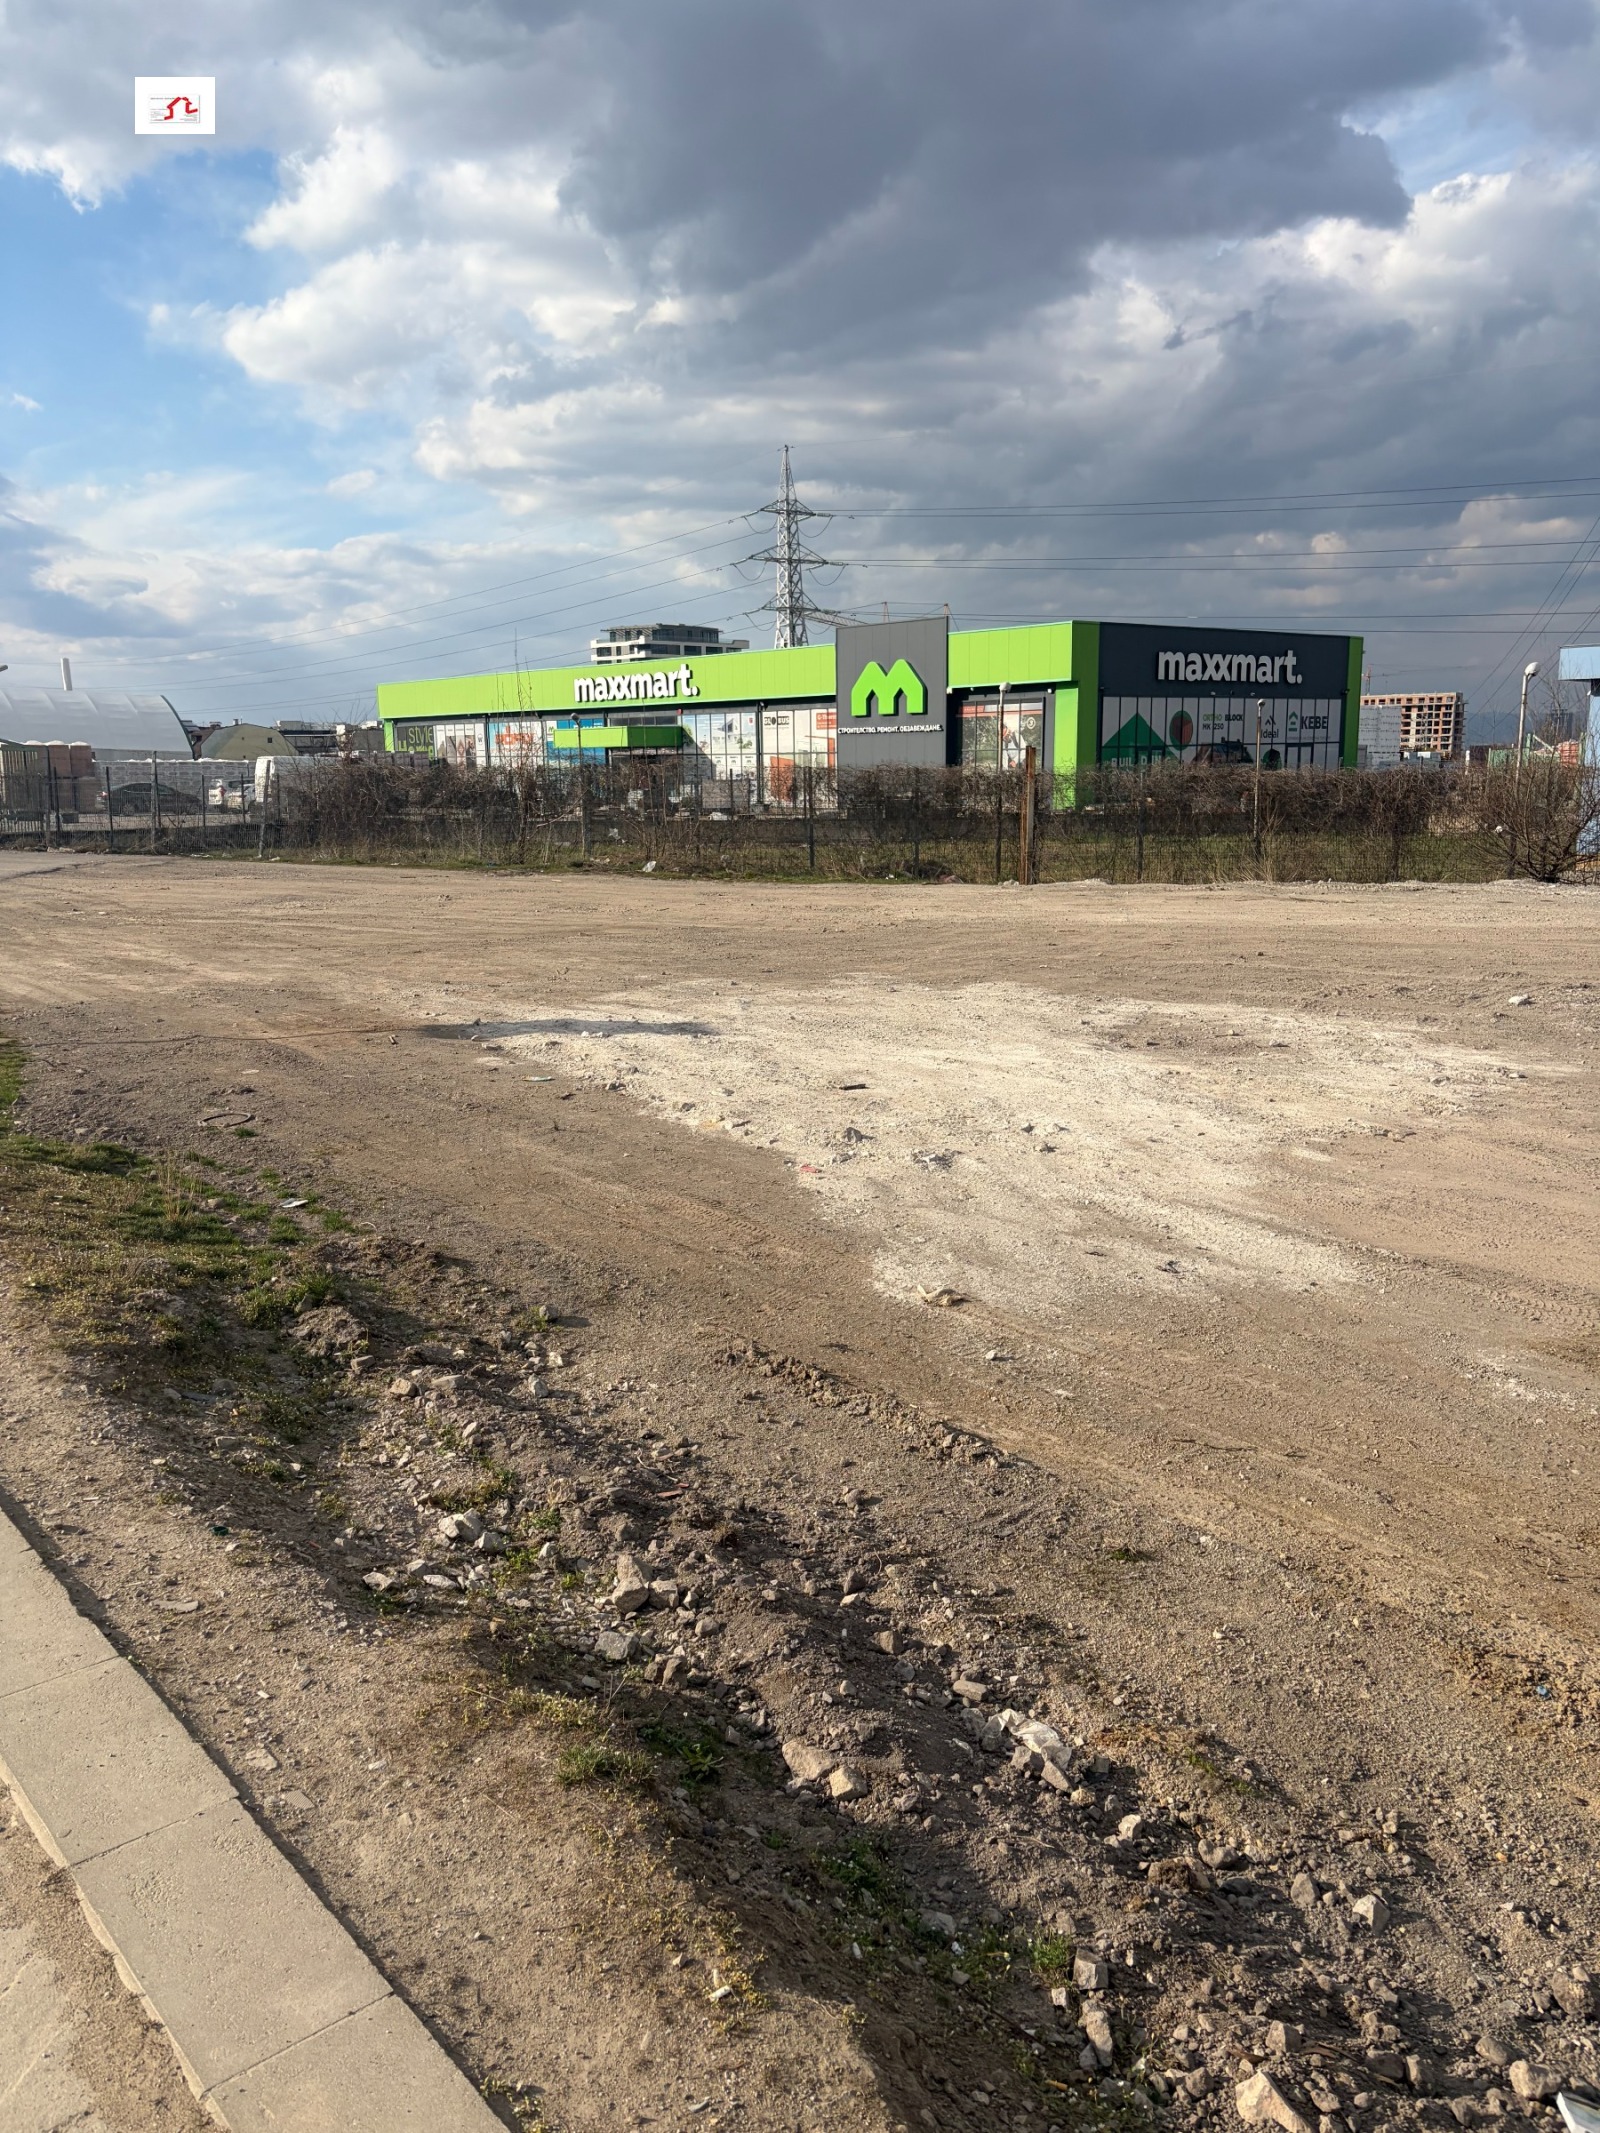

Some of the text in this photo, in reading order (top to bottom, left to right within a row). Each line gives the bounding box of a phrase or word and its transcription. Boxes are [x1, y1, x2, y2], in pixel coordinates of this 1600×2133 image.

[1157, 648, 1303, 684] maxxmart.
[573, 663, 699, 703] maxxmart.
[1202, 713, 1243, 722] ORTHO BLOCK
[1300, 715, 1329, 730] KEBE
